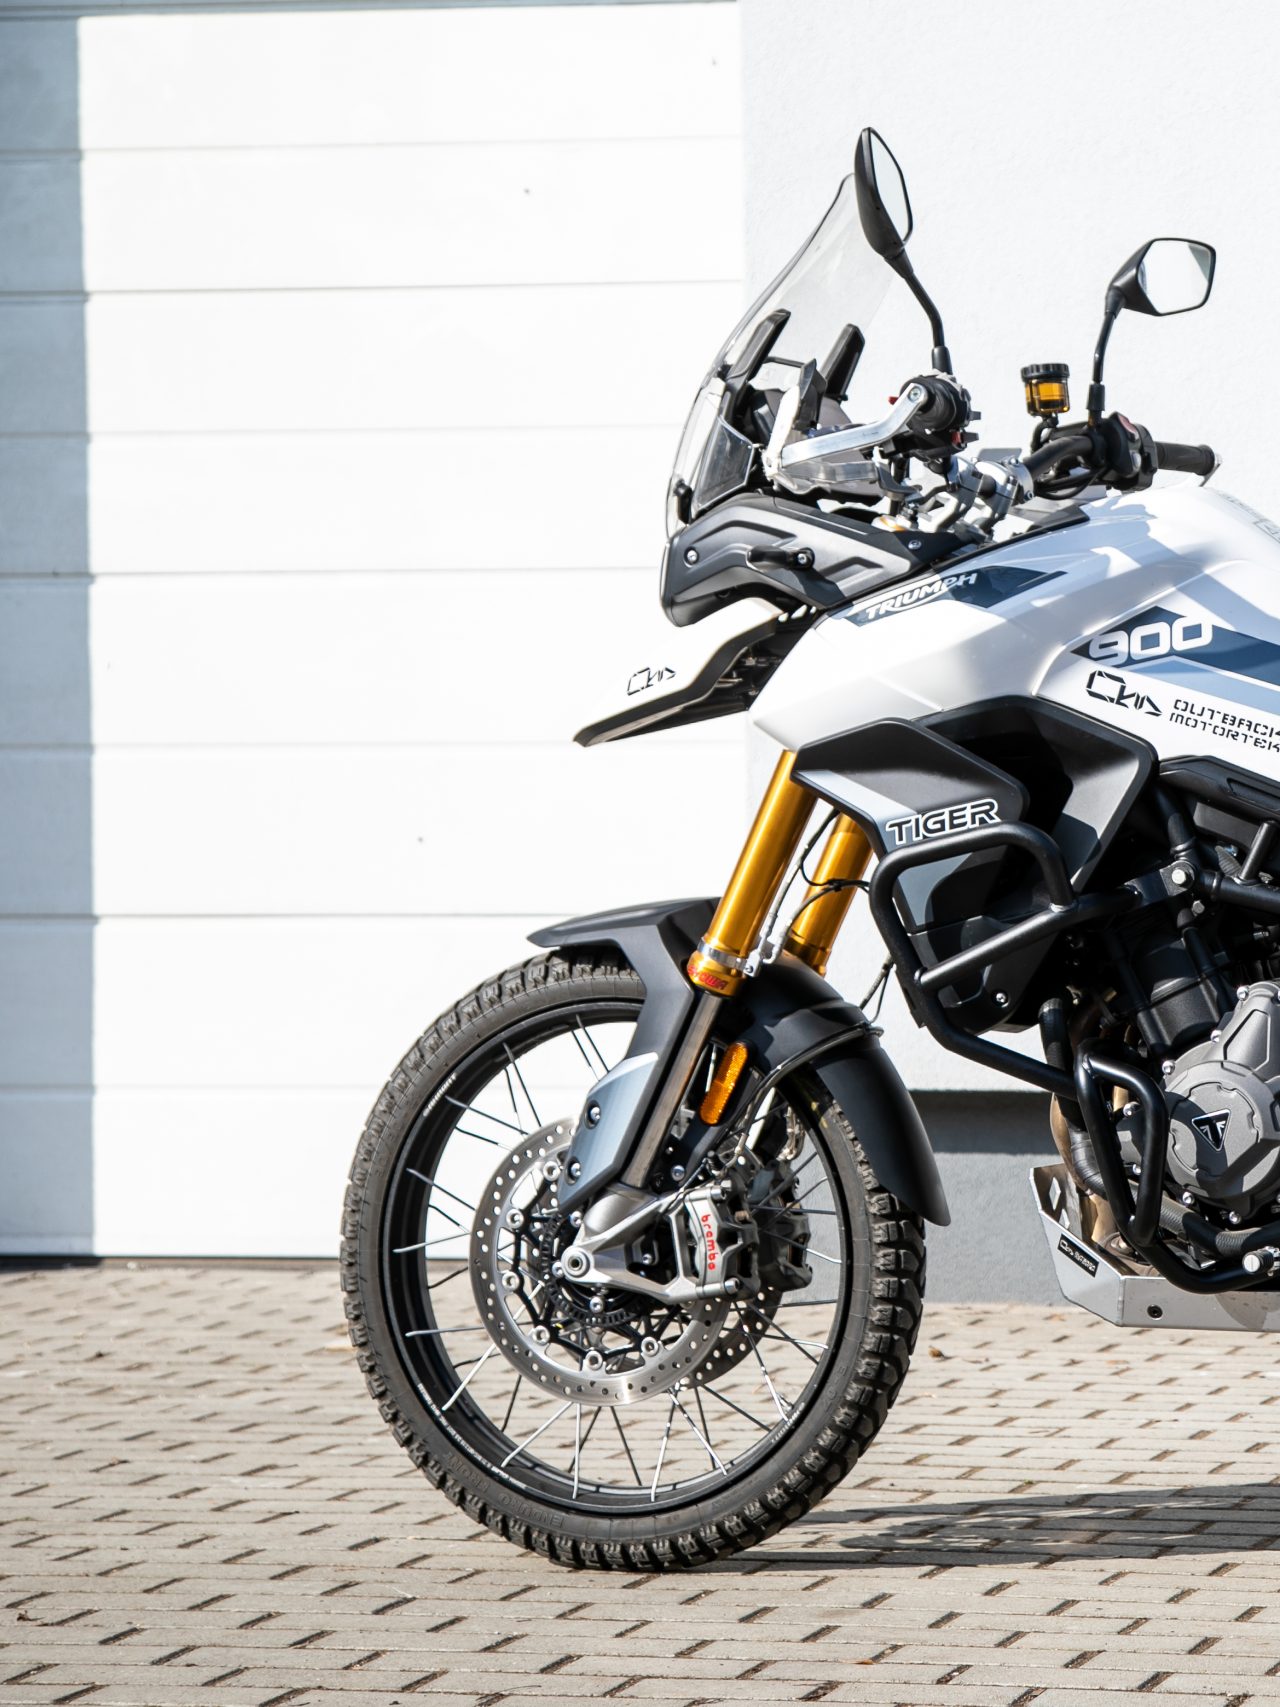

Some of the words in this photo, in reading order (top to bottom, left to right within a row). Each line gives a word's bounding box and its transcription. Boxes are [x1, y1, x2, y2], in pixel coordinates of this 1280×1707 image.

[865, 573, 978, 620] TRIUMPH
[1088, 616, 1213, 666] 900
[1169, 712, 1280, 753] MOTORTEK
[885, 798, 1002, 846] TIGER
[701, 1213, 719, 1271] brembo
